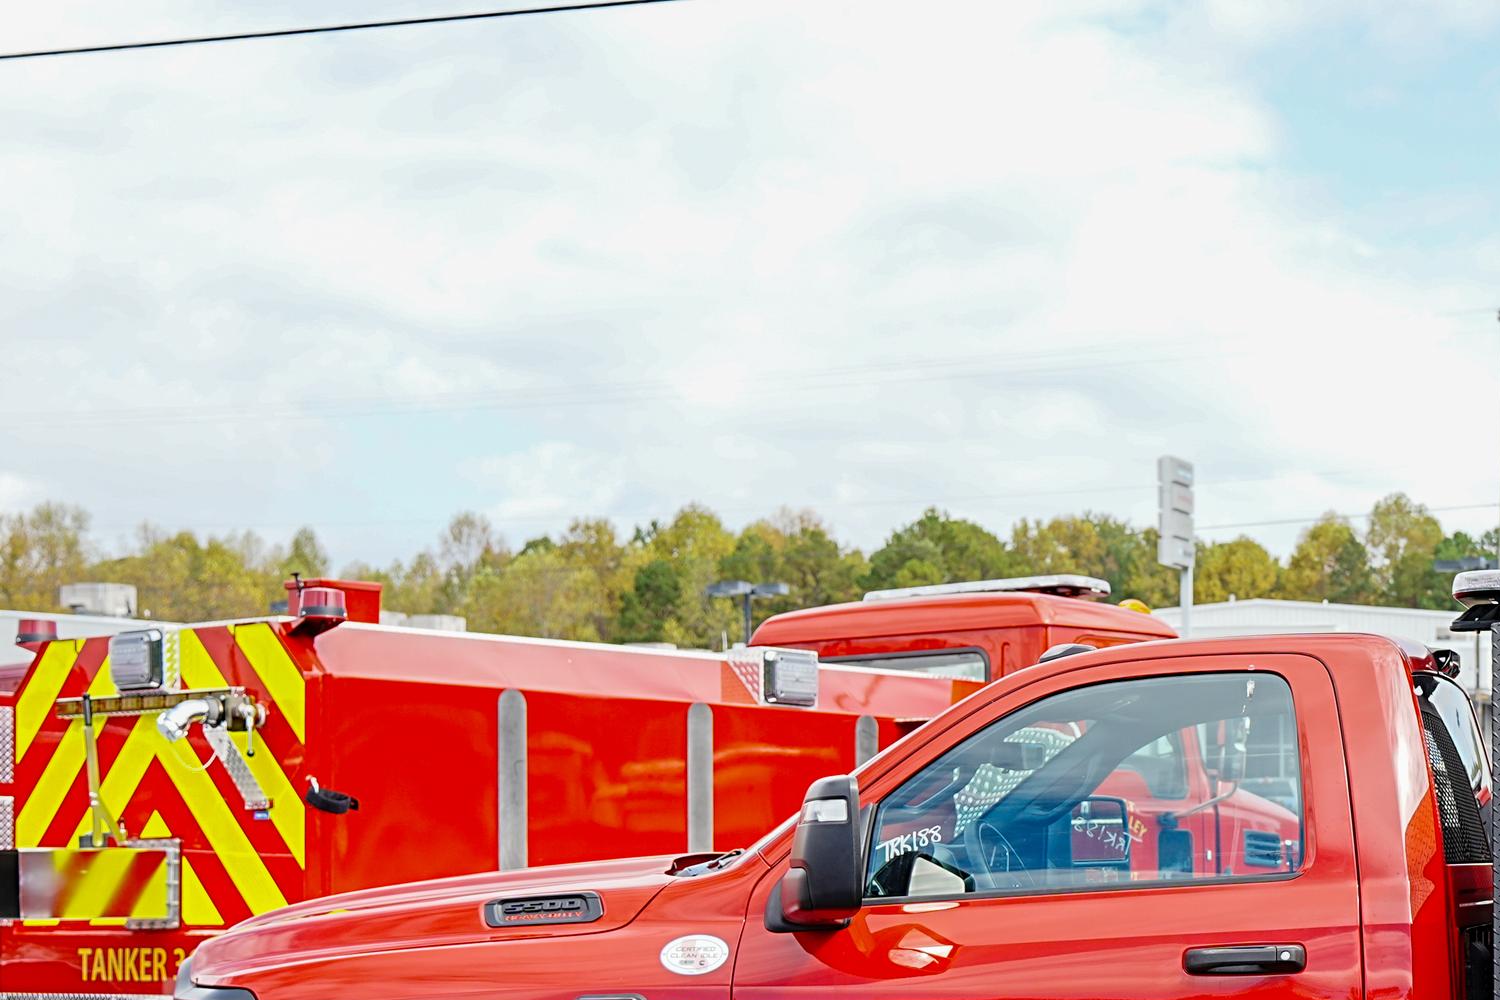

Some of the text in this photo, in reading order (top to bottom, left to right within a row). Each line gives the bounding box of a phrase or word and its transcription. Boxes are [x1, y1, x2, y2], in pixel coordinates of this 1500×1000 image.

[876, 825, 942, 862] TRK188
[504, 900, 581, 914] 5500
[77, 947, 196, 982] TANKER 3
